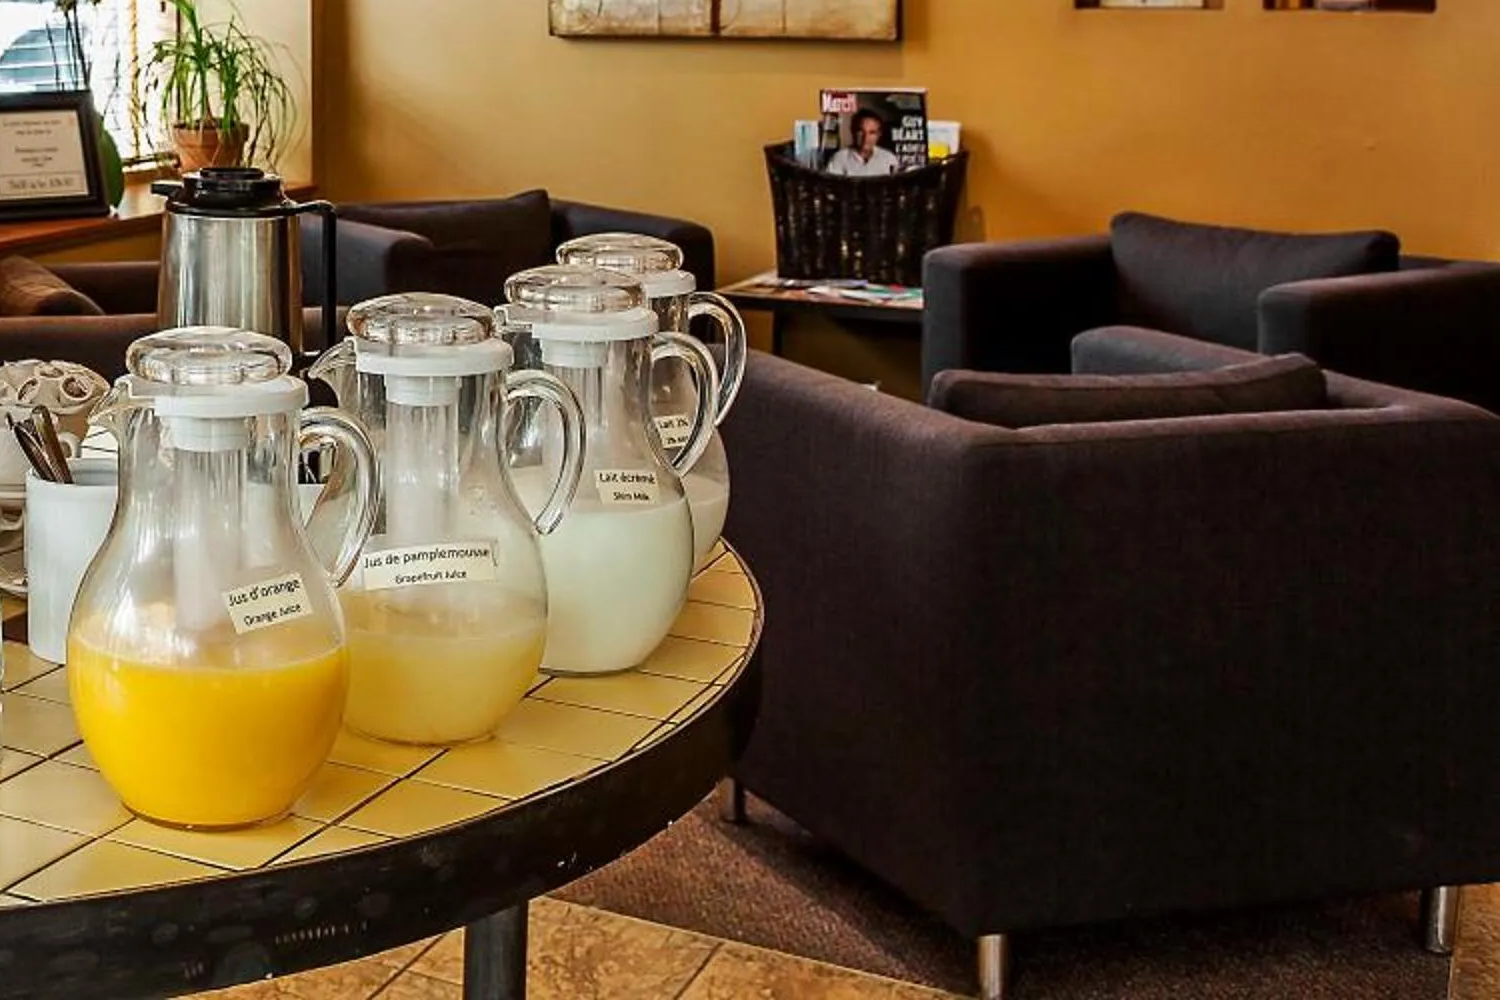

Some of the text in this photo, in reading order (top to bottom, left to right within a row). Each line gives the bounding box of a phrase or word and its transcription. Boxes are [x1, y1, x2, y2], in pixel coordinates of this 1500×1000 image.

[599, 472, 618, 483] Lait
[612, 490, 649, 501] Skim Milk
[363, 547, 490, 569] Jus de pamplemousse
[228, 579, 301, 607] Jus d'orange
[243, 610, 278, 626] Orange
